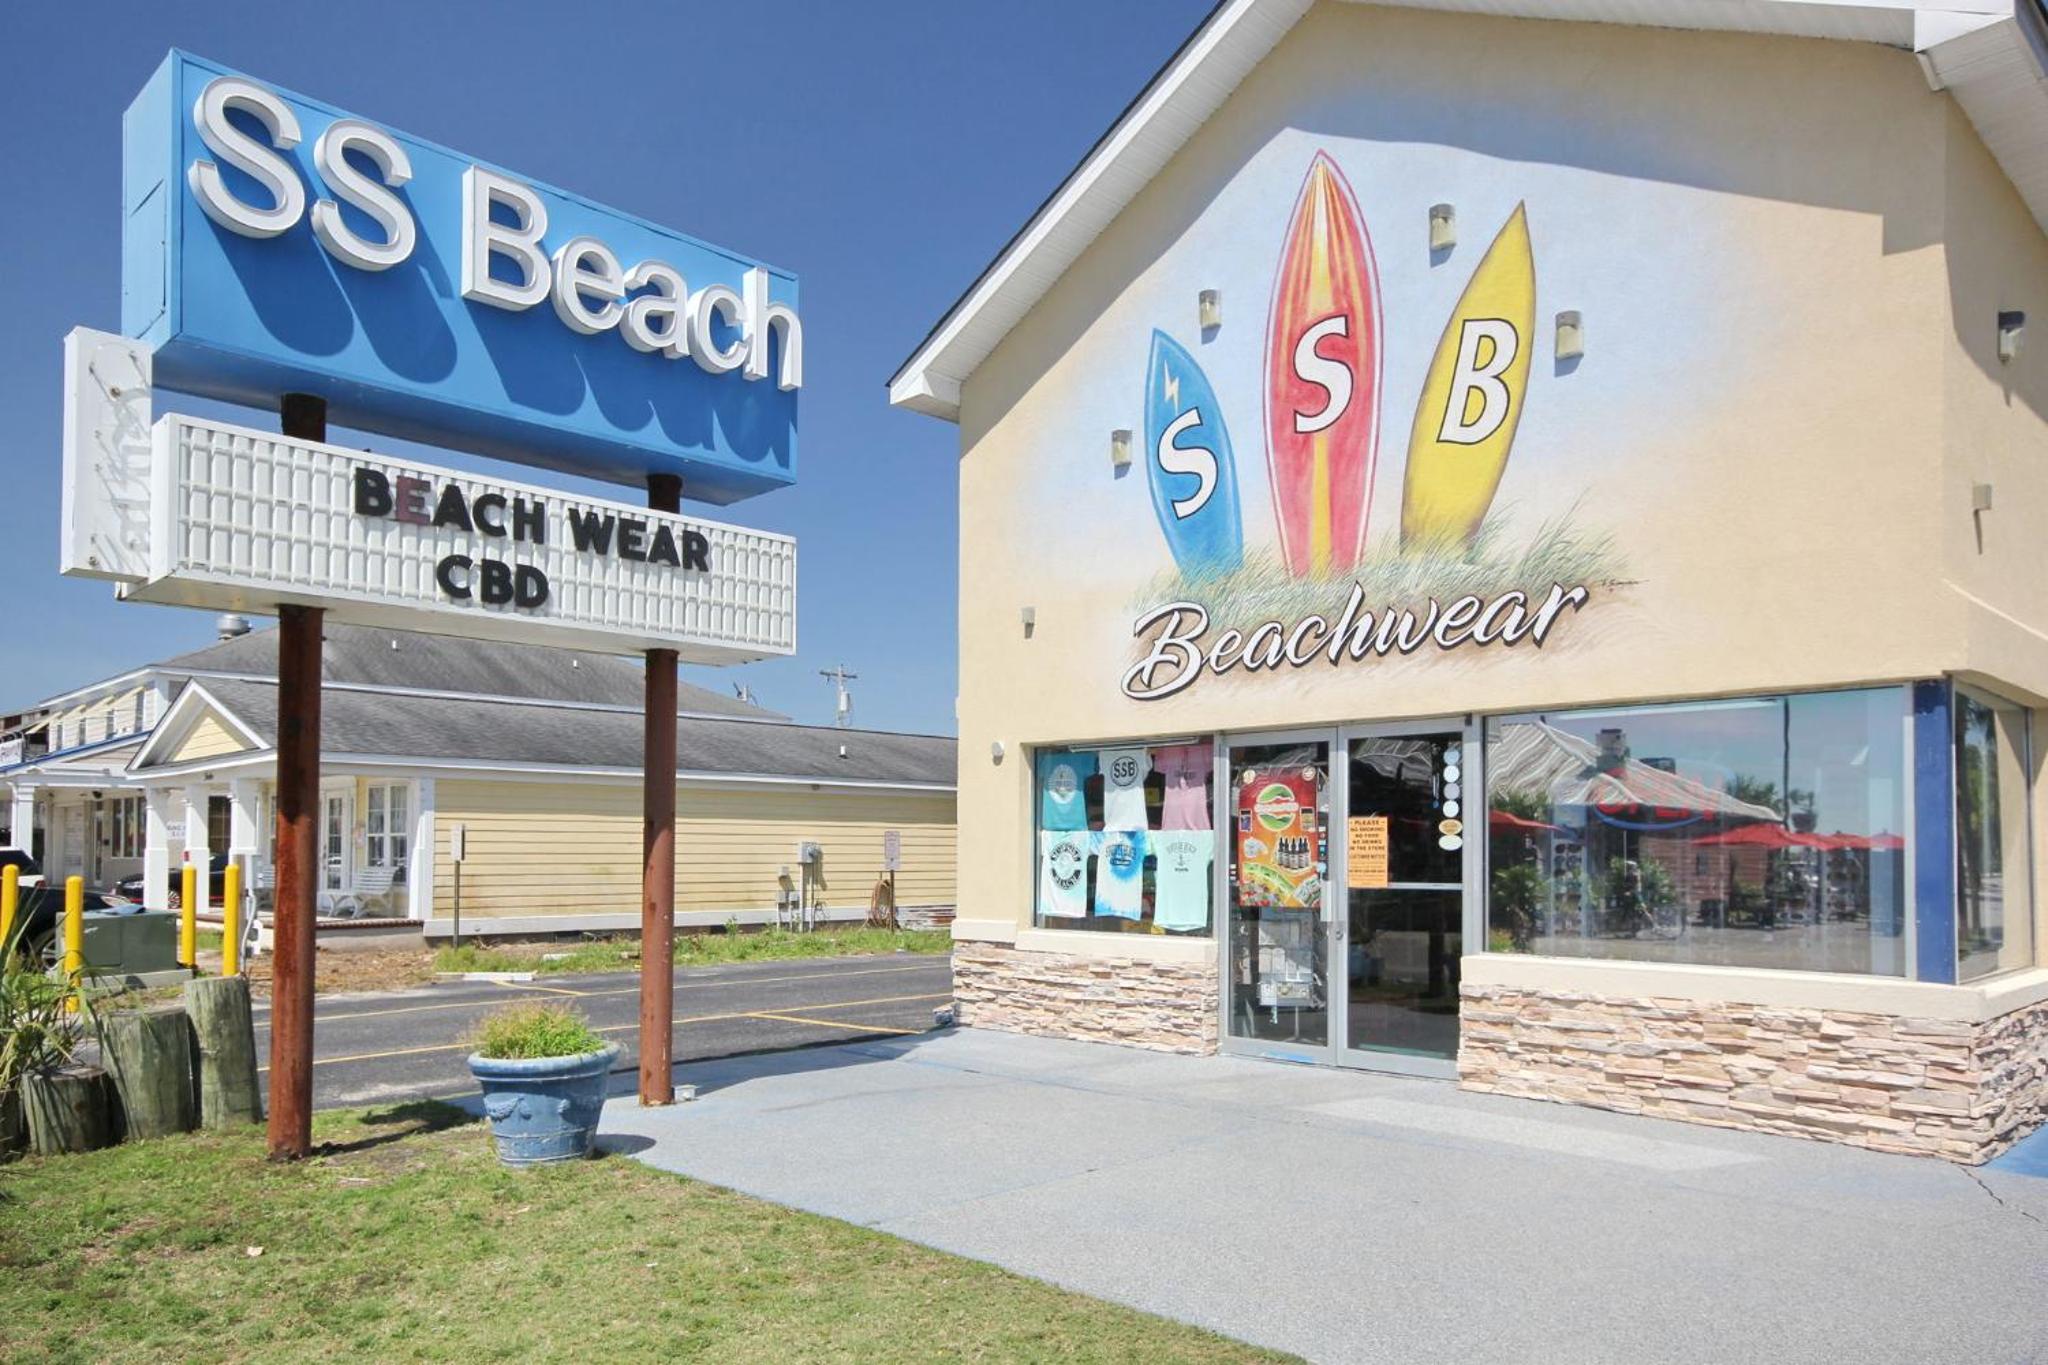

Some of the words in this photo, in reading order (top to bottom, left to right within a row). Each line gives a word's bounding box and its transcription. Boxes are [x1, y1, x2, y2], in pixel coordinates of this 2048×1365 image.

[188, 76, 415, 271] SS
[462, 165, 802, 391] Beach
[354, 467, 546, 545] BEACH
[567, 507, 710, 573] WEAR
[436, 554, 550, 608] CBD
[1120, 581, 1590, 701] Beachwear
[1113, 761, 1136, 778] SSB
